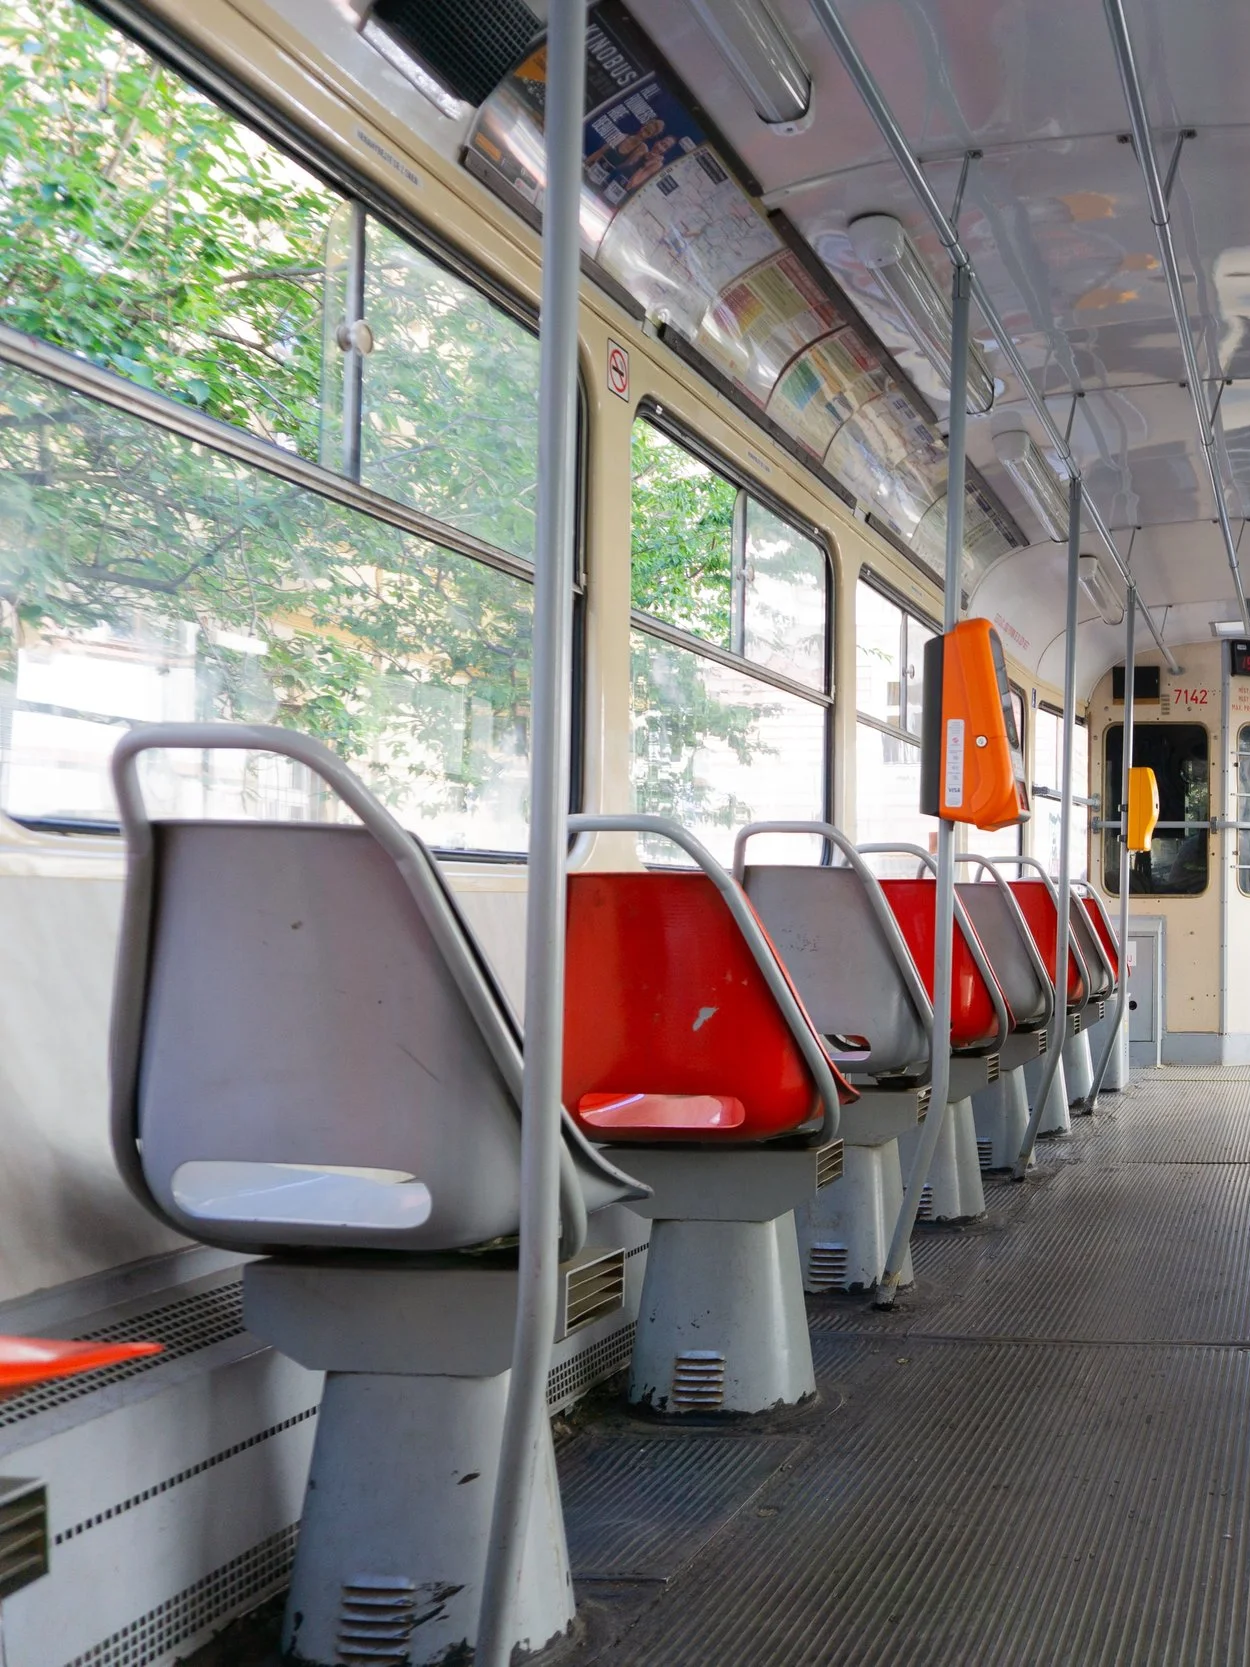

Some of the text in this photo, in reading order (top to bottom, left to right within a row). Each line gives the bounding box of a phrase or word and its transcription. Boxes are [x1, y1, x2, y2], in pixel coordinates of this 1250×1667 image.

[586, 22, 638, 86] KINOBUS
[623, 92, 657, 124] RUNNERS
[1174, 689, 1208, 705] 7142
